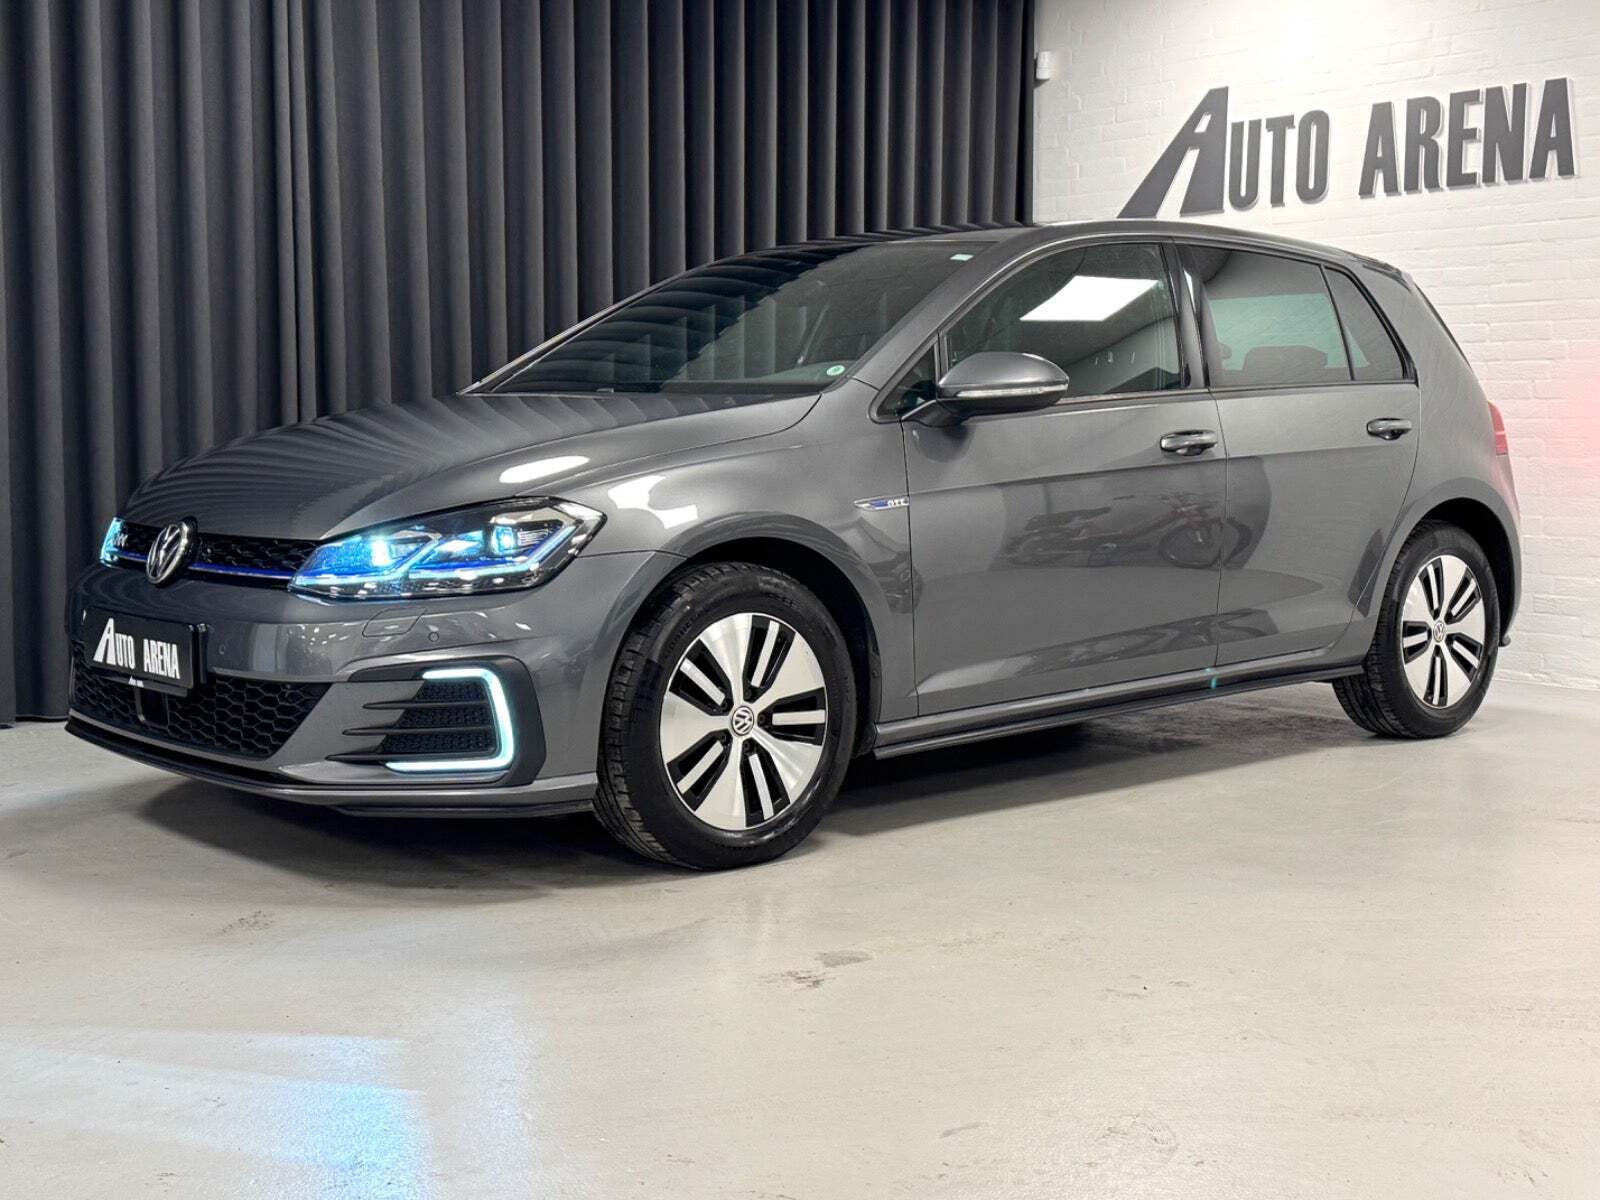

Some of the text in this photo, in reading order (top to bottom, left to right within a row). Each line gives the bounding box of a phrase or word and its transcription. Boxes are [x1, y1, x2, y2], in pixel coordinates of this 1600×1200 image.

[1116, 77, 1576, 218] AUTO ARENA
[93, 618, 181, 680] AUTO ARENA
